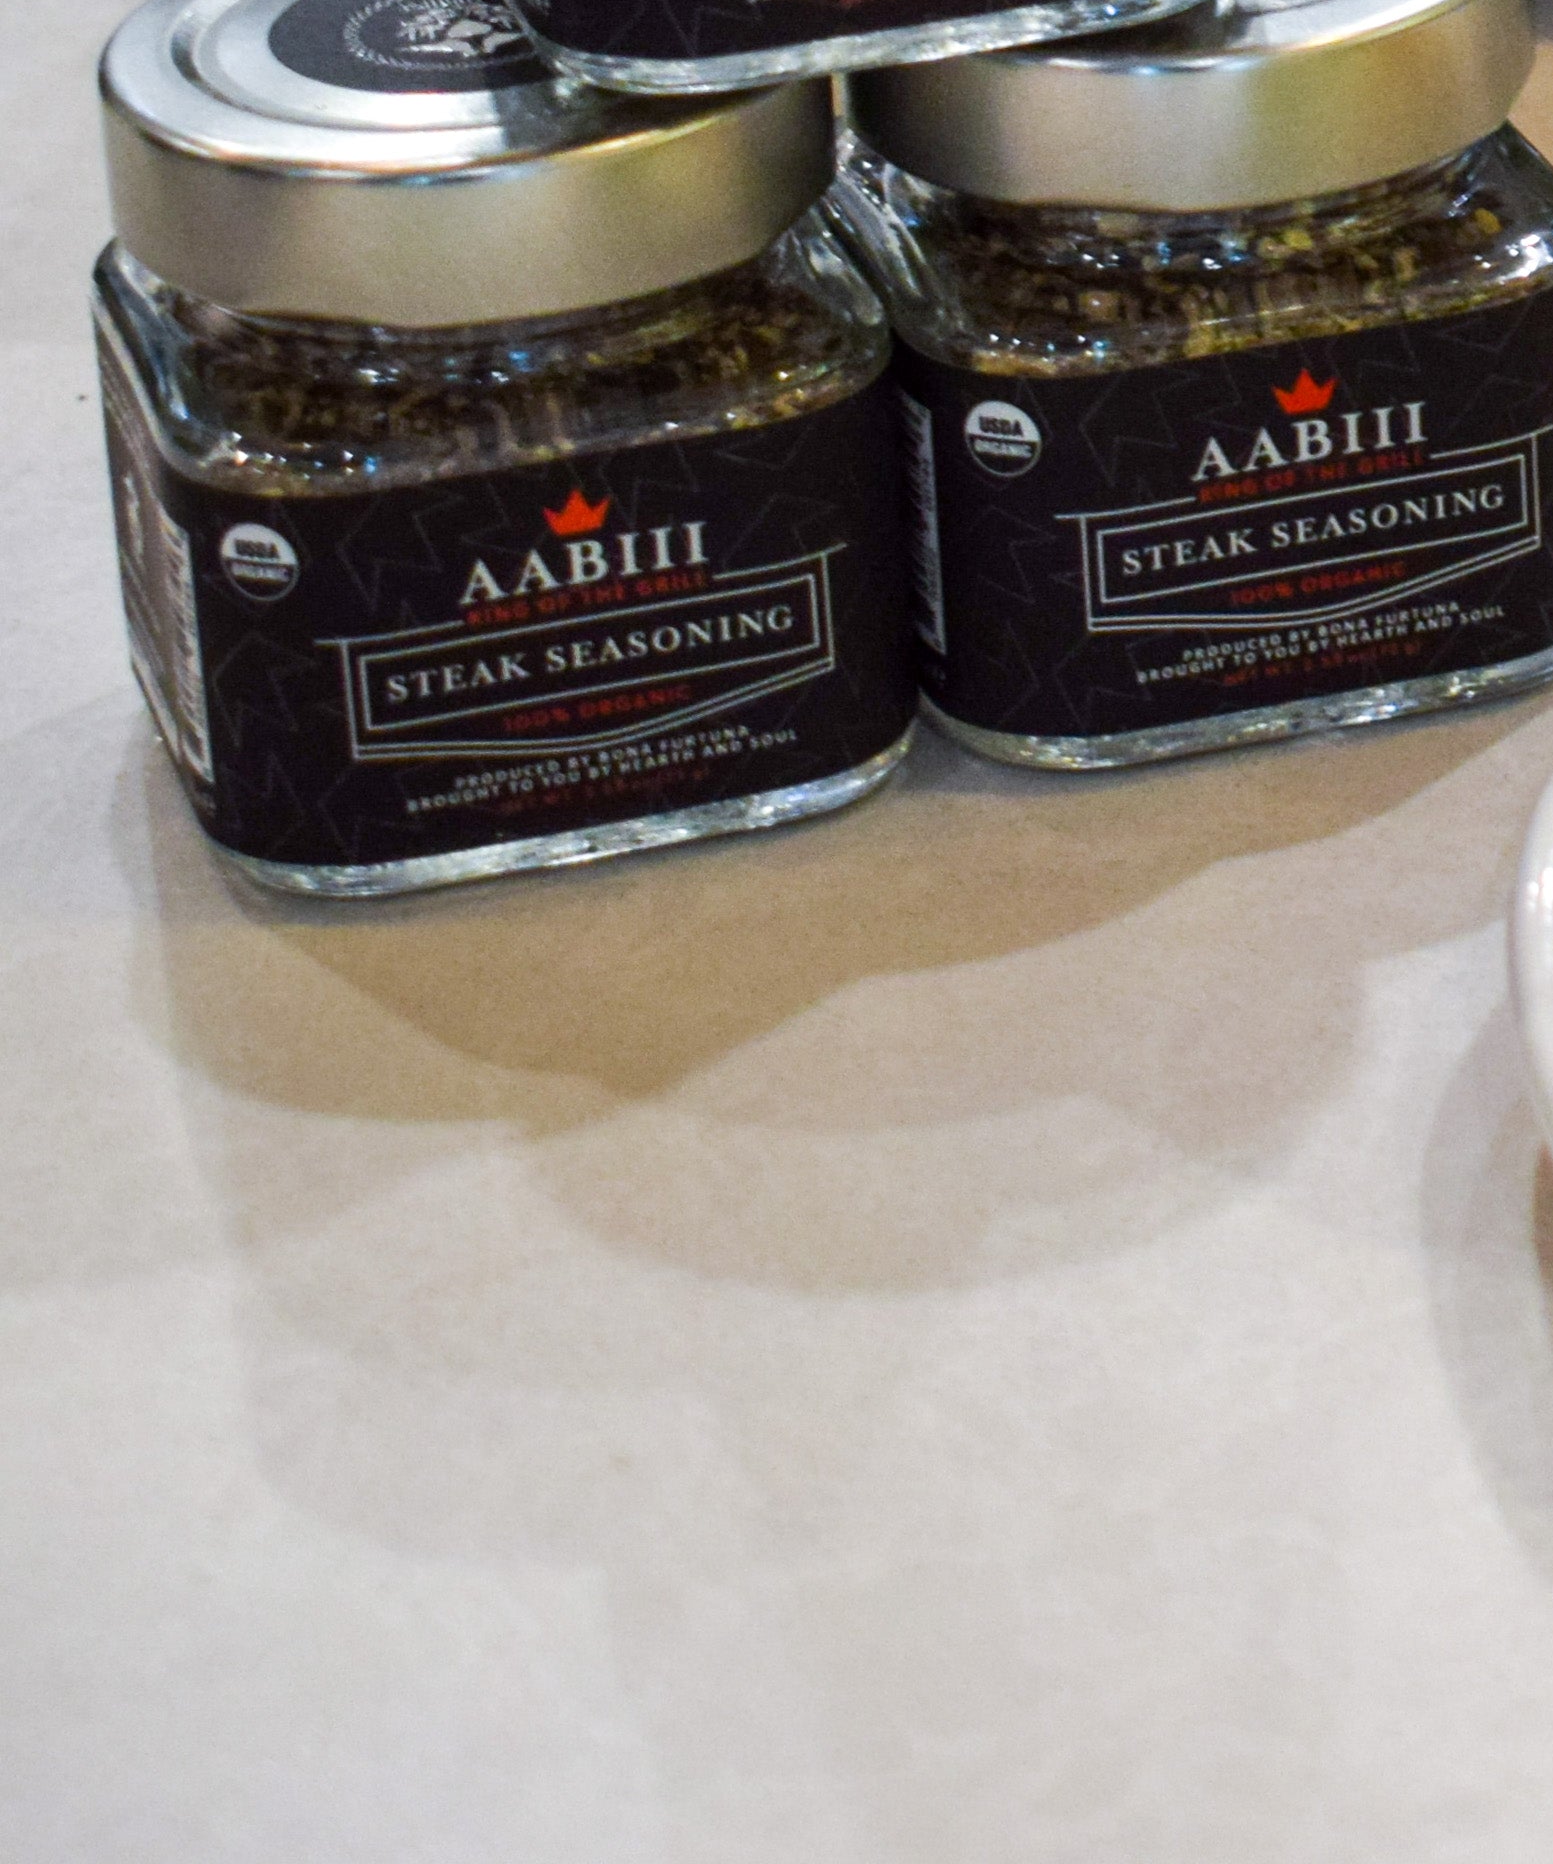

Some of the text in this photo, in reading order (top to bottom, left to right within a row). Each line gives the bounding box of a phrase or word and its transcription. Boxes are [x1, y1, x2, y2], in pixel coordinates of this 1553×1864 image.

[974, 438, 1032, 458] ORGANIC
[979, 416, 1023, 436] USDA
[1191, 401, 1428, 482] AABIII
[459, 521, 708, 605] AABIII
[1122, 484, 1505, 576] STEAK SEASONING
[387, 604, 794, 705] STEAK SEASONING
[1137, 605, 1504, 684] BROUGHT TO YOU BY HEARTH AND SOUL
